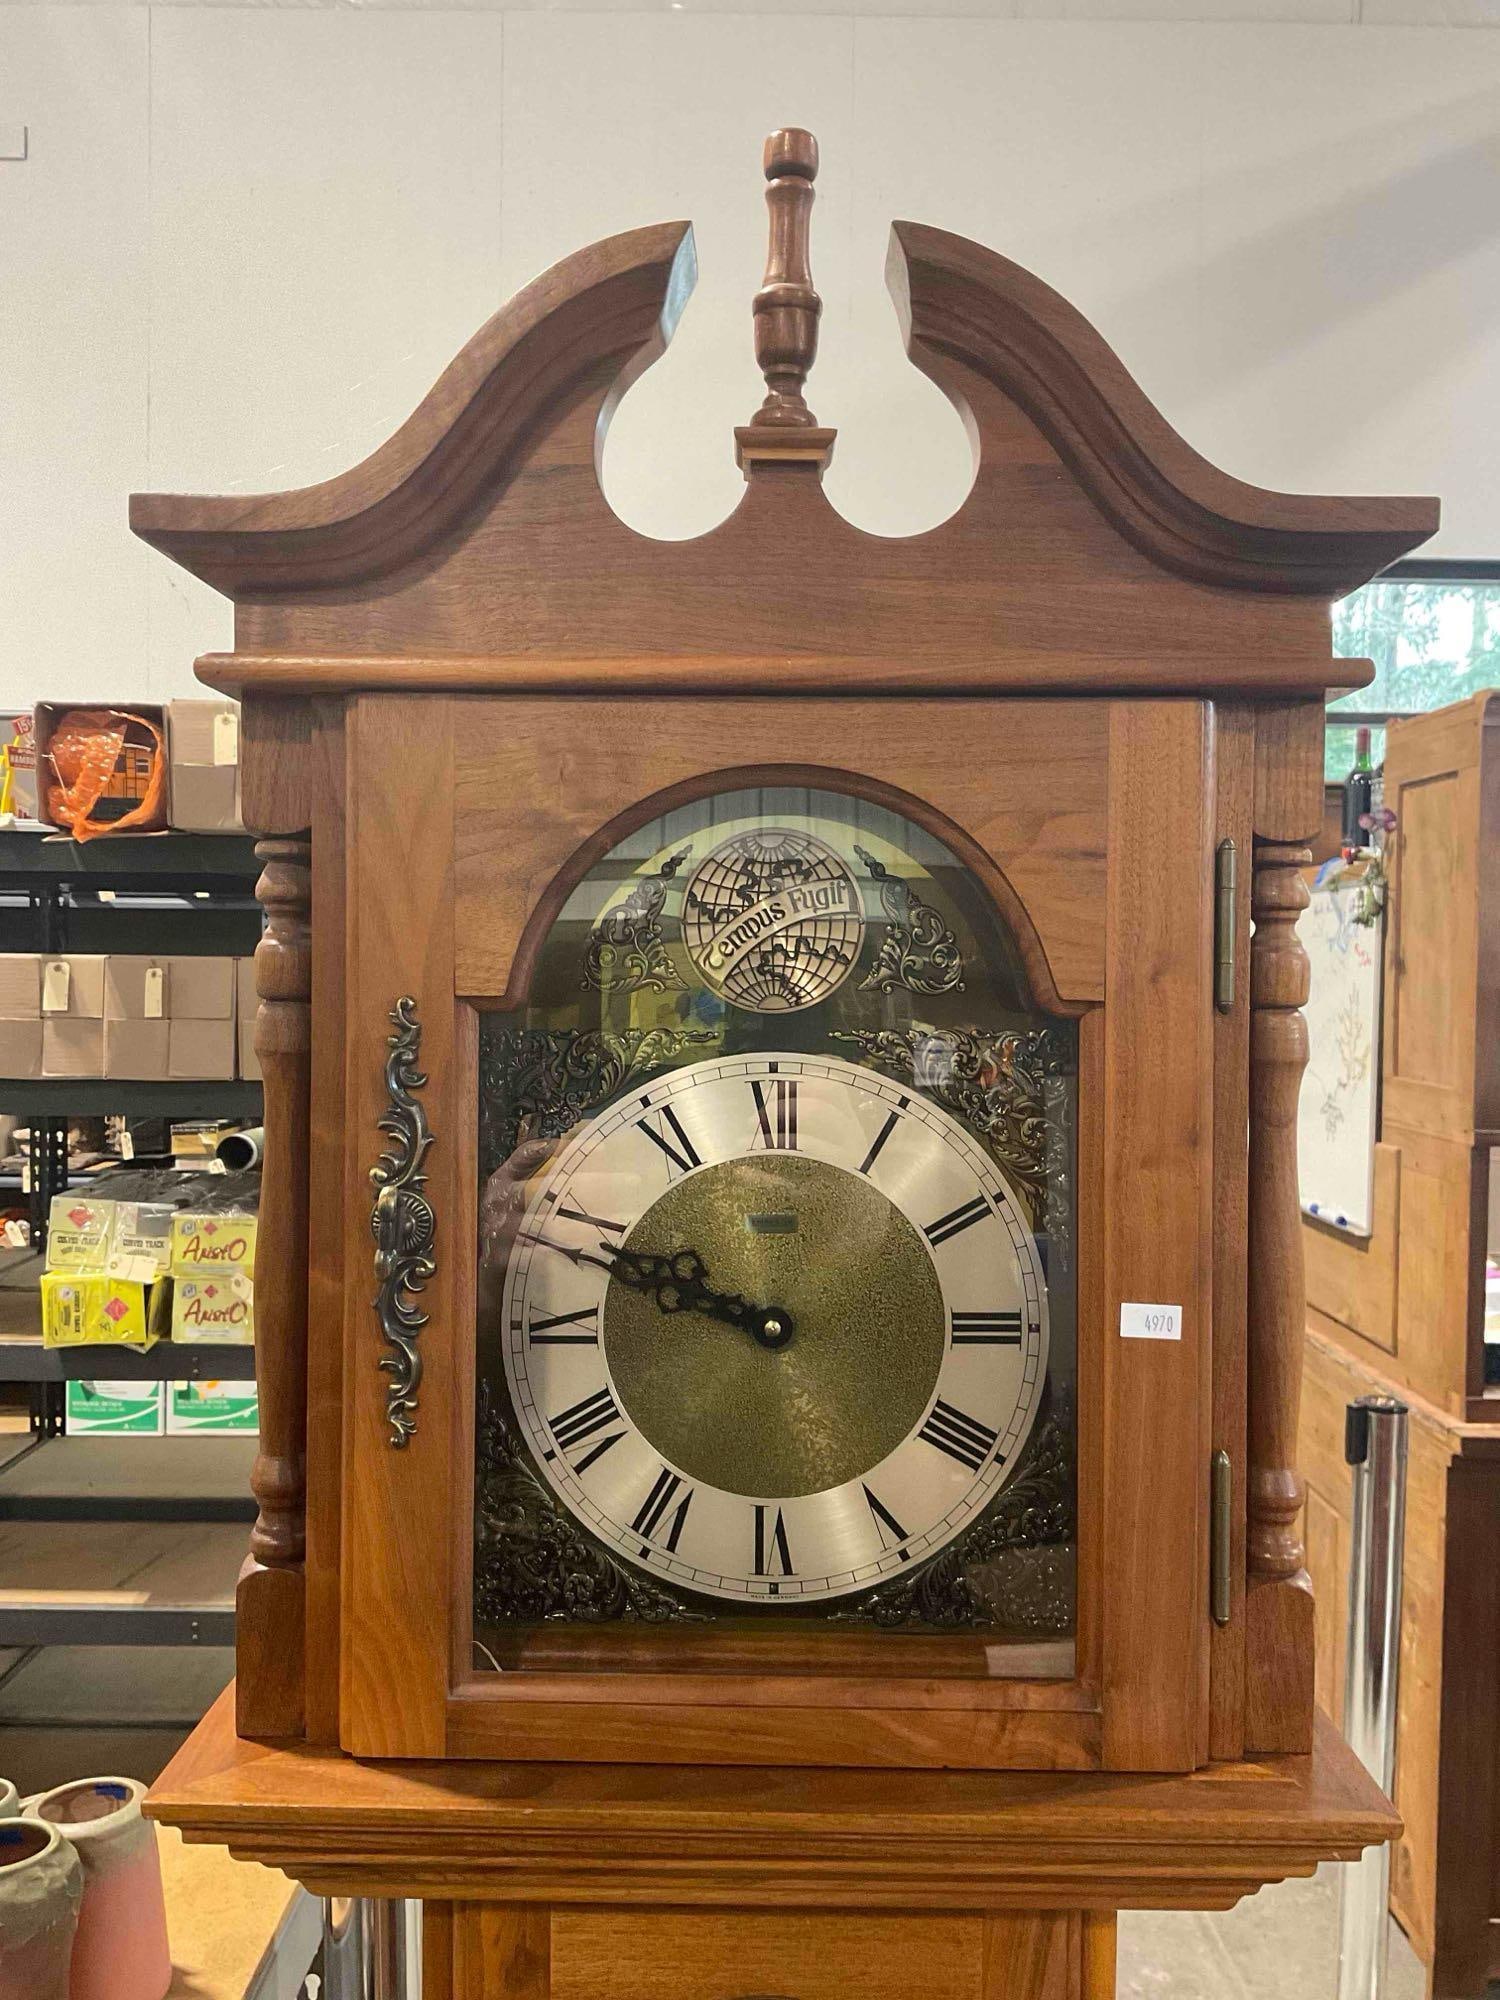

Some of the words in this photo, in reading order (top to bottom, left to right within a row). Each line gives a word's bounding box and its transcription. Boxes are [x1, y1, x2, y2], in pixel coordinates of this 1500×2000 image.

[703, 902, 786, 969] Tempus
[787, 881, 846, 914] Fugit
[635, 1102, 705, 1183] XI
[746, 1080, 803, 1151] XII
[856, 1108, 905, 1178] I
[918, 1190, 996, 1248] II
[950, 1307, 1022, 1350] III
[1144, 1314, 1173, 1333] 4970
[917, 1396, 998, 1472] IIII
[749, 1504, 799, 1576] VI
[862, 1482, 914, 1552] V
